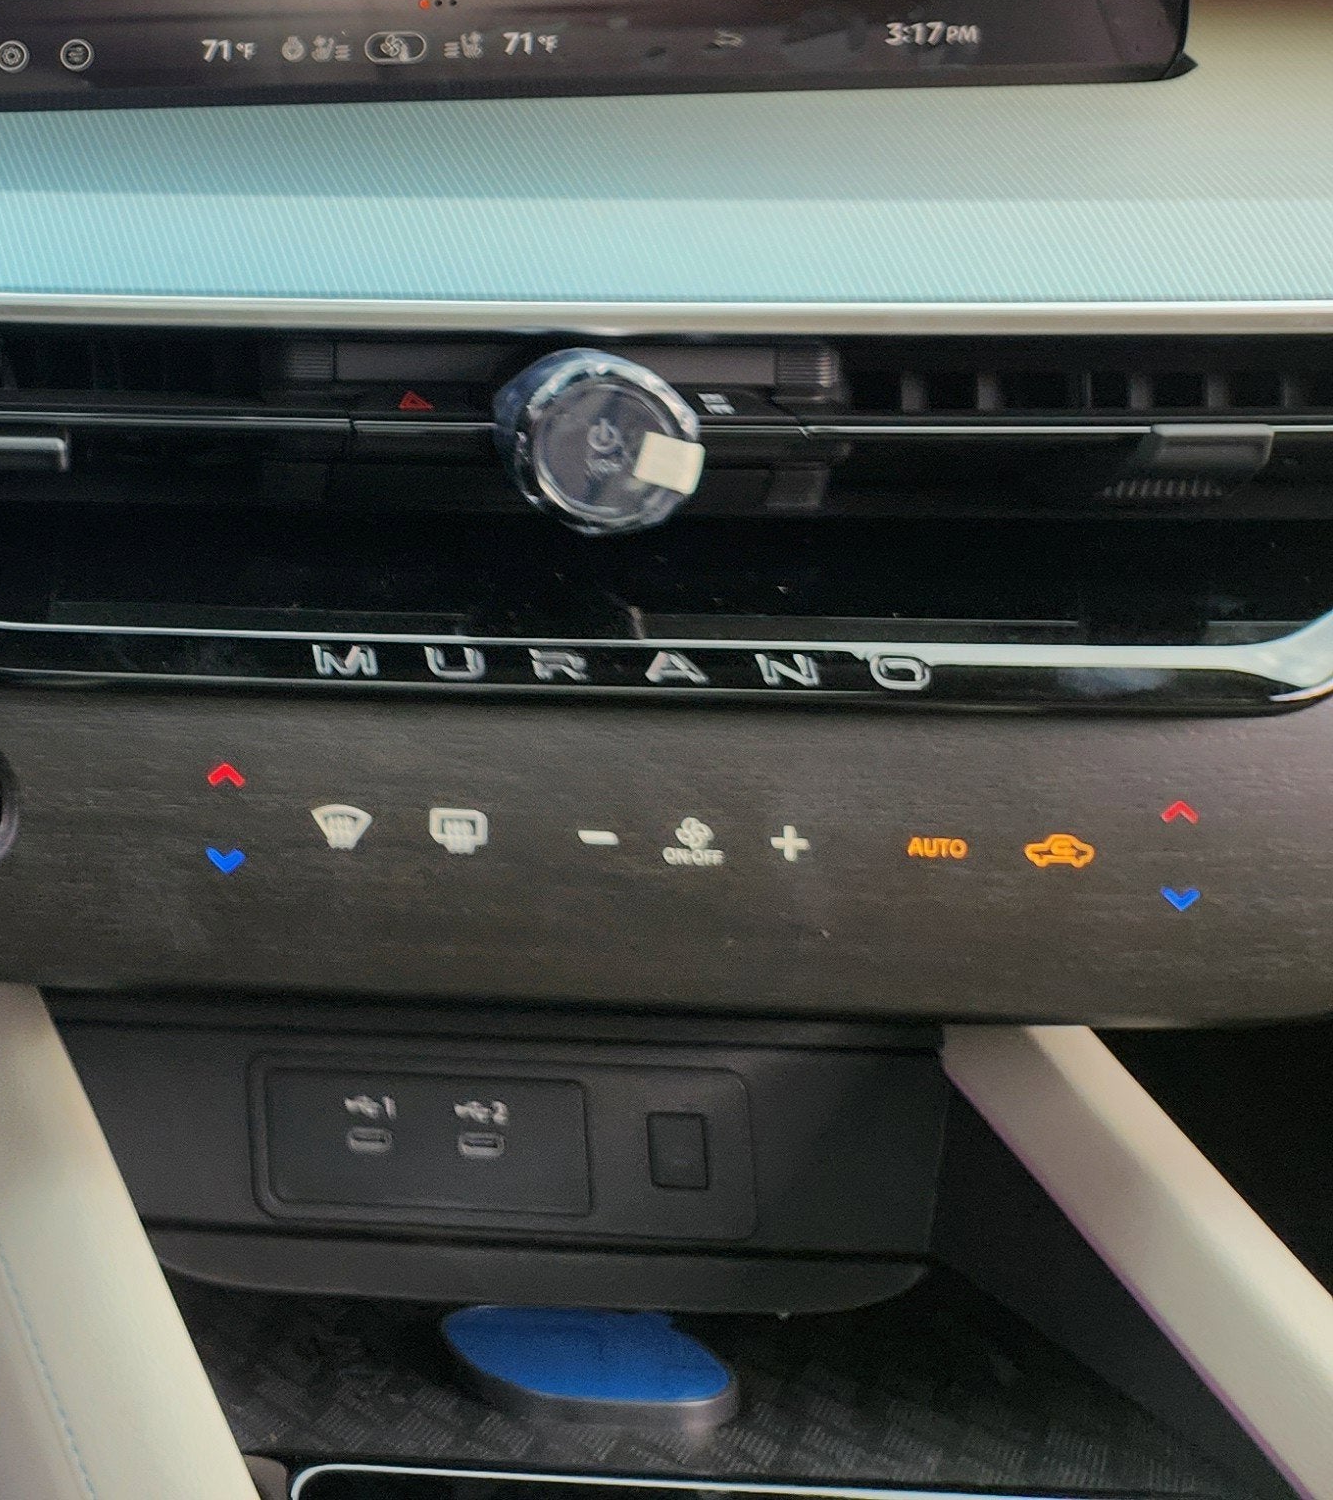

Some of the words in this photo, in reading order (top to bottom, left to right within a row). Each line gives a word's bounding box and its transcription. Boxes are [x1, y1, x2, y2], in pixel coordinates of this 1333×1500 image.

[502, 32, 533, 55] 71
[884, 21, 945, 46] 3:17
[946, 24, 981, 45] PM
[201, 38, 233, 62] 71
[311, 643, 932, 691] MURANO
[907, 837, 969, 859] AUTO
[382, 1096, 397, 1121] 1
[491, 1100, 509, 1126] 2
